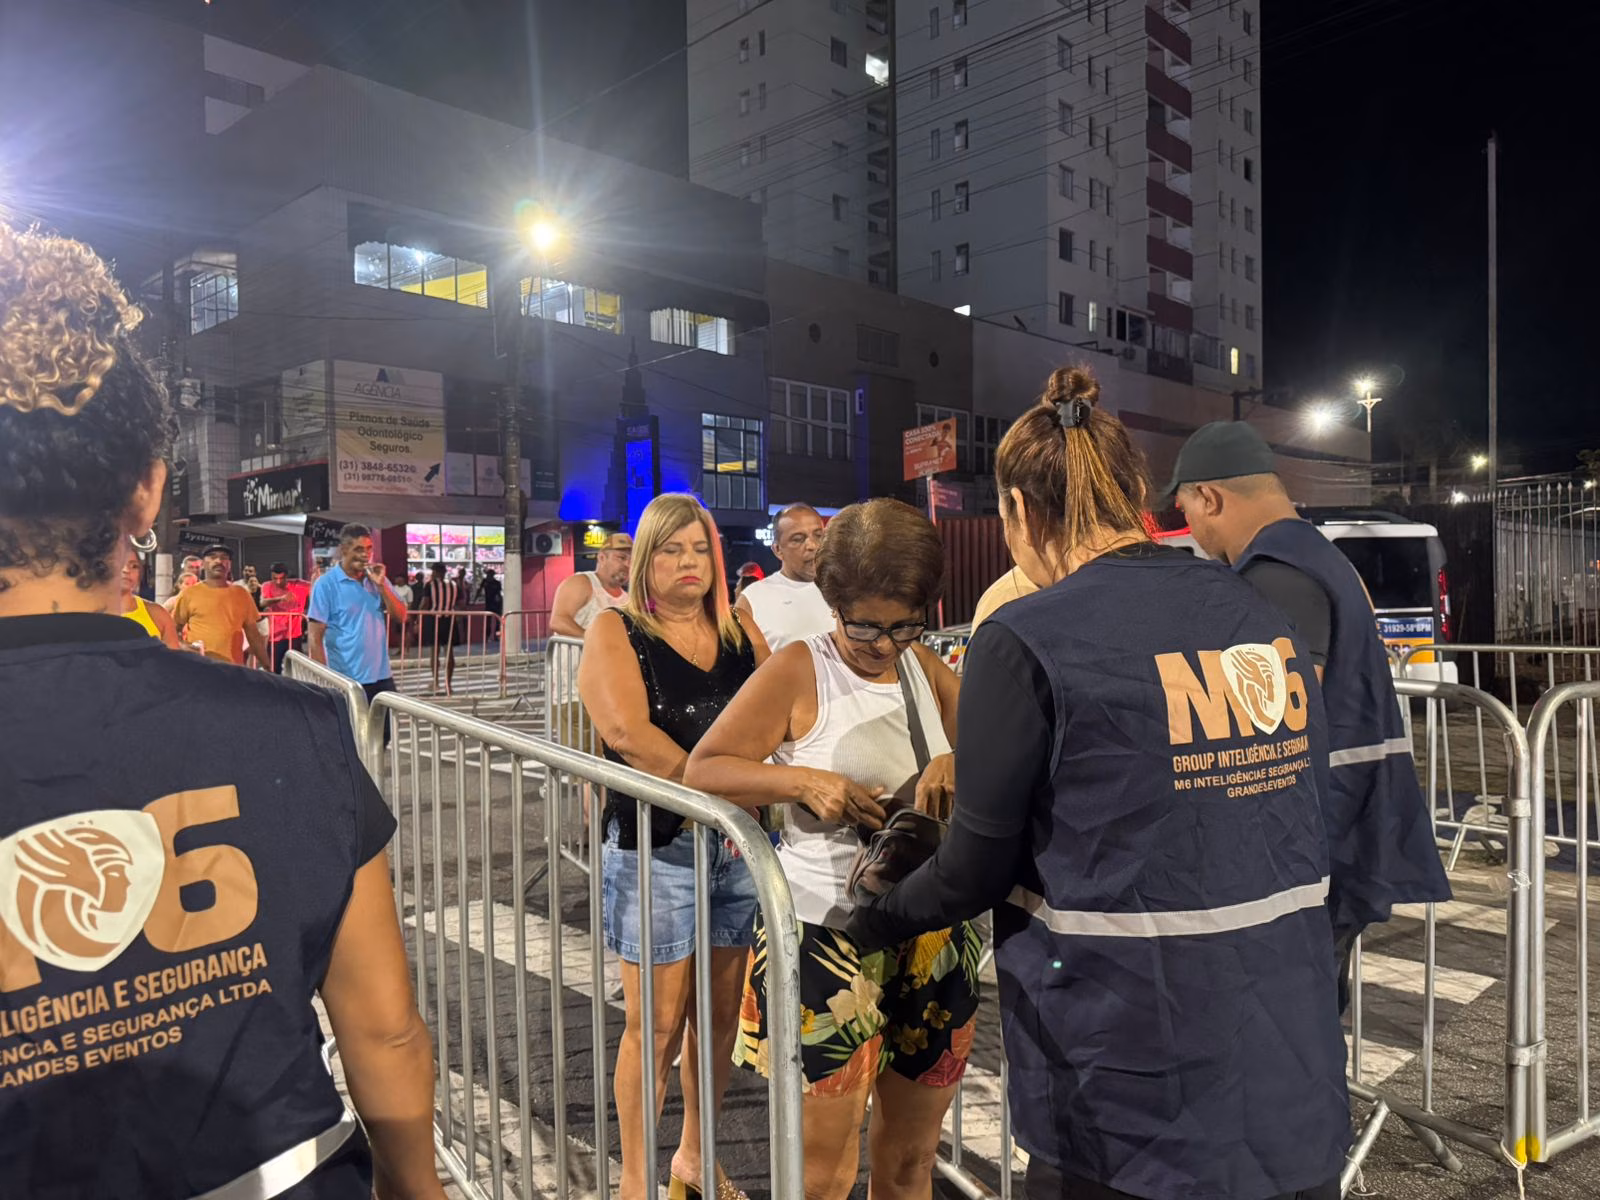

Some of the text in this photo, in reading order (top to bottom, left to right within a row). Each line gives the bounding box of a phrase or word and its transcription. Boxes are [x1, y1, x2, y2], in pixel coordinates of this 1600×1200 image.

[354, 382, 401, 399] AGÊNCIA
[349, 411, 430, 428] Planos de Saúde
[358, 426, 424, 442] Odontológico
[370, 441, 412, 454] Seguros.
[339, 460, 358, 471] (31)
[344, 473, 359, 482] (31)
[1173, 752, 1215, 773] GROUP
[1217, 743, 1277, 768] INTELIGÊNCIA
[1174, 779, 1192, 790] M6
[1194, 771, 1260, 788] INTELIGÊNCIA
[1260, 768, 1267, 778] E
[1268, 761, 1304, 778] SEGURANÇA
[1227, 774, 1296, 798] GRANDES EVENTOS
[0, 943, 267, 1038] LIGÊNCIA E SEGURANÇA
[62, 1033, 77, 1051] E
[83, 994, 215, 1045] SEGURANÇA
[219, 978, 272, 1005] LTDA
[84, 1026, 183, 1069] EVENTOS
